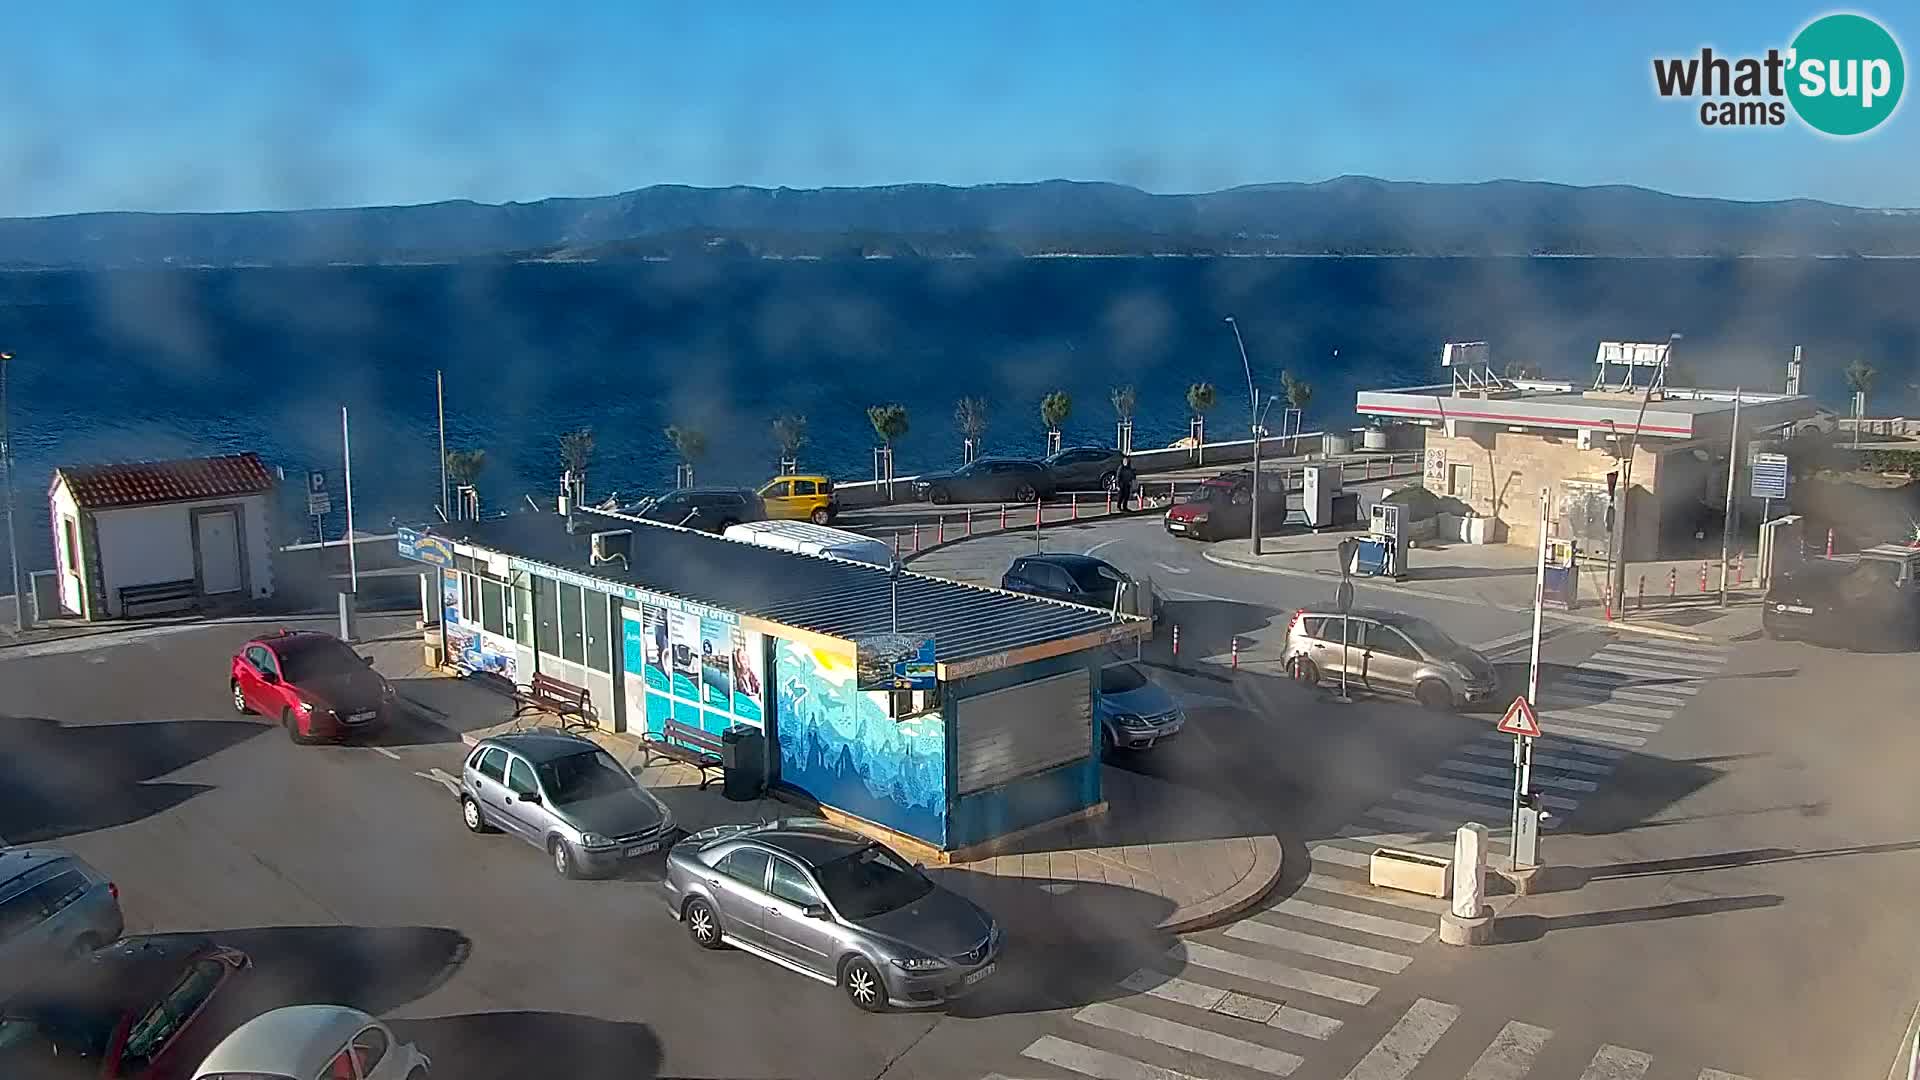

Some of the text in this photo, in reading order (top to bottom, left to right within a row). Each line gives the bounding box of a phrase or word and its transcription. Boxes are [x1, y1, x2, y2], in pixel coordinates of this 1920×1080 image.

[312, 473, 324, 491] P
[650, 595, 681, 610] STATION
[682, 603, 708, 616] TICKET
[709, 610, 735, 623] OFFICE
